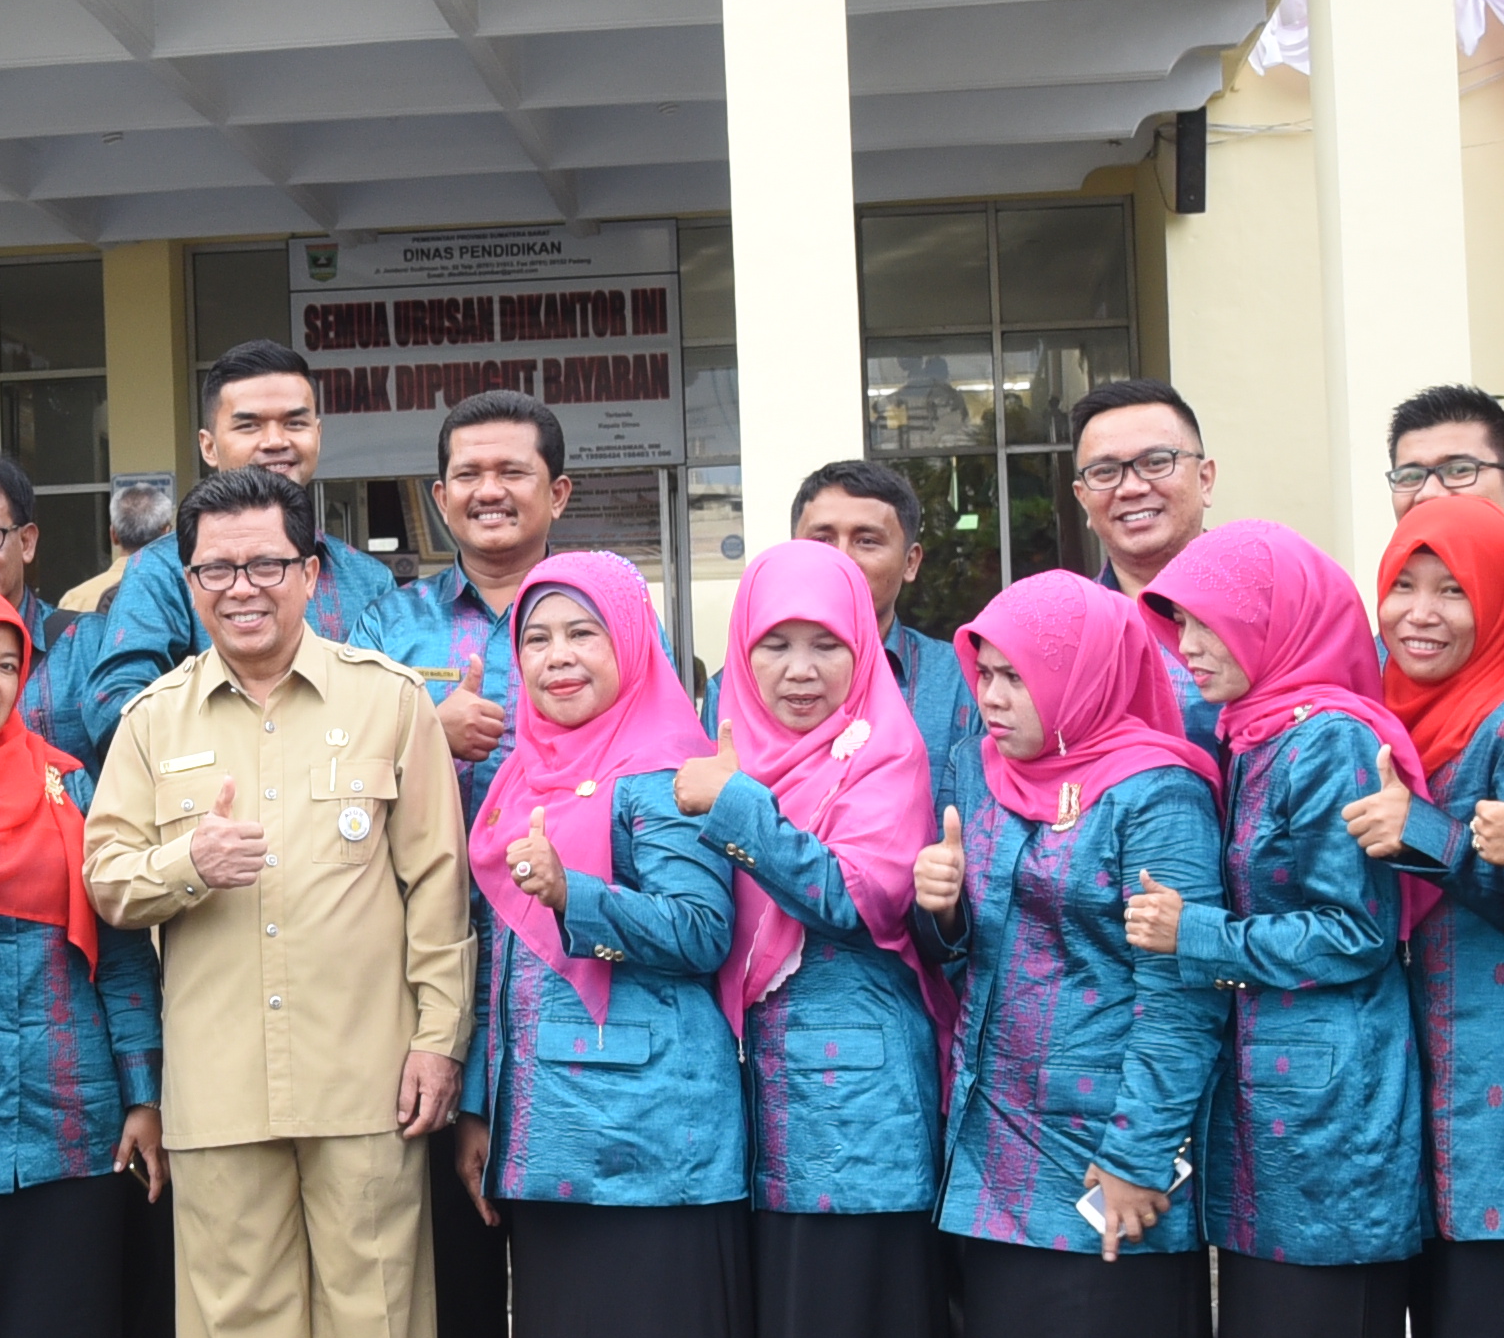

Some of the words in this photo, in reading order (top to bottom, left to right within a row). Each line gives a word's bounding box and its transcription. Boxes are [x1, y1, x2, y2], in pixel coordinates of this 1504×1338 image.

[403, 247, 454, 262] DINAS
[459, 241, 562, 260] PENDIDIKAN
[489, 231, 526, 240] SUMATERA
[528, 230, 550, 238] BARAT
[303, 301, 390, 352] SEMUA
[393, 295, 495, 347] URUSAN
[498, 289, 627, 342] DIKANTOR
[630, 287, 668, 336] INI
[310, 365, 392, 415] TIDAK
[542, 352, 671, 405] BAYARAN
